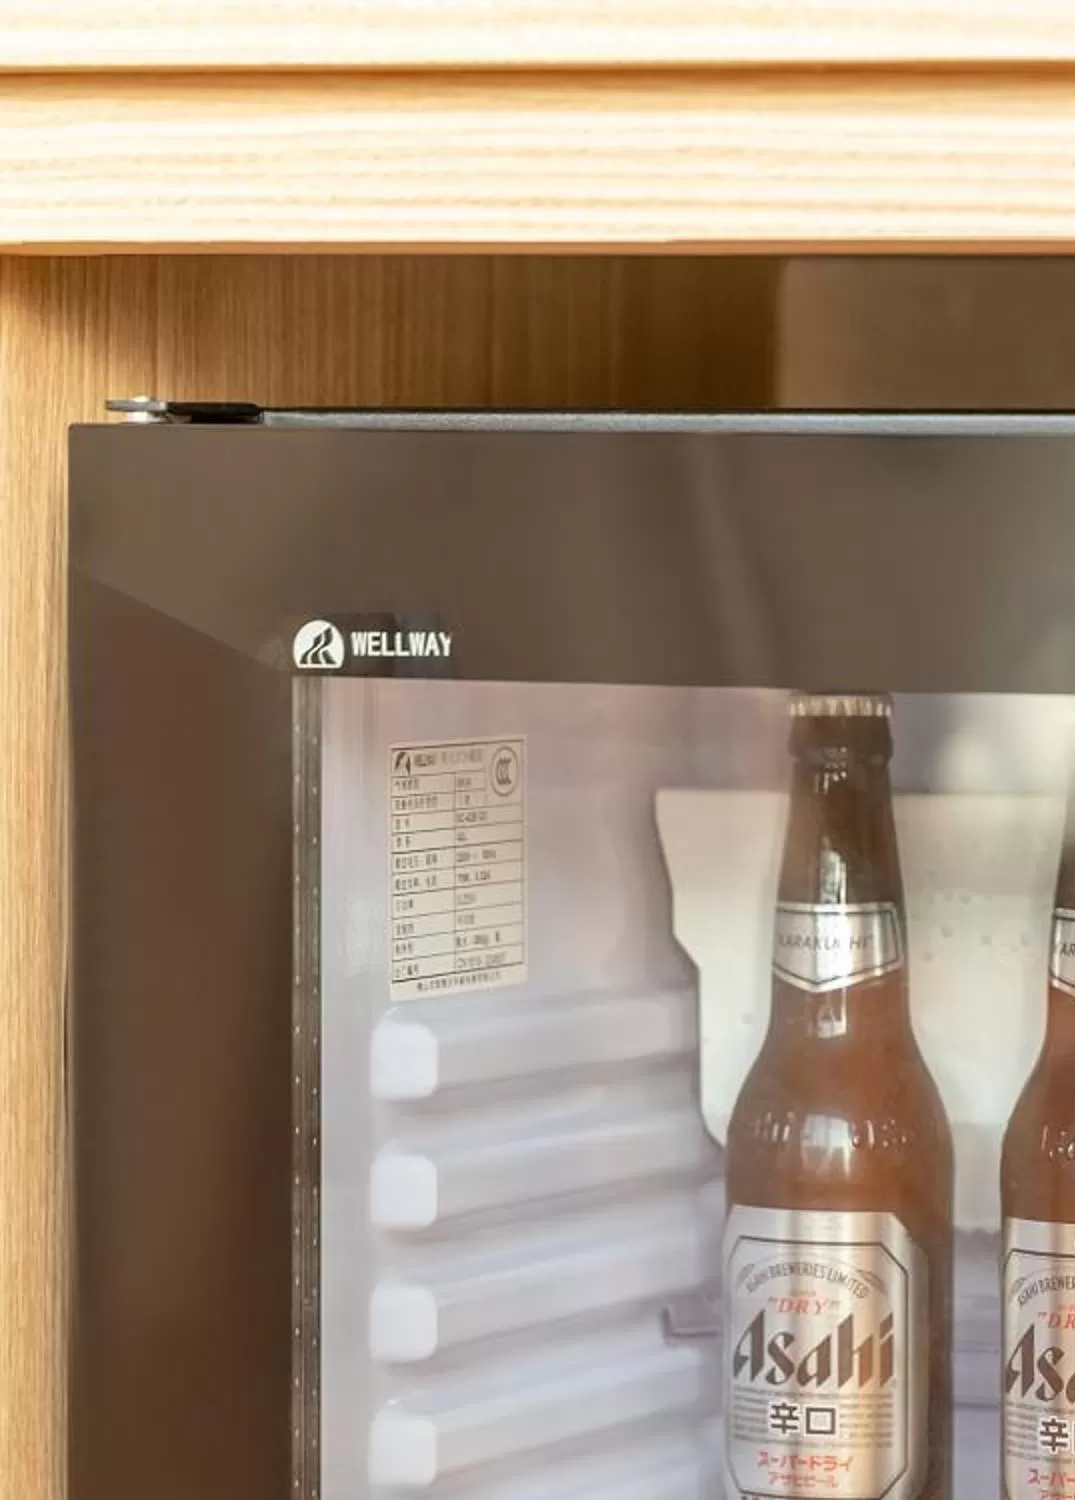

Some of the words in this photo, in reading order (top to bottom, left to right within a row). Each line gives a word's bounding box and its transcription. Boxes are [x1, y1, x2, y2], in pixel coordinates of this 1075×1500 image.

[350, 631, 452, 657] WELLWAY
[732, 1308, 894, 1389] Asahi
[769, 1402, 837, 1435] 辛口
